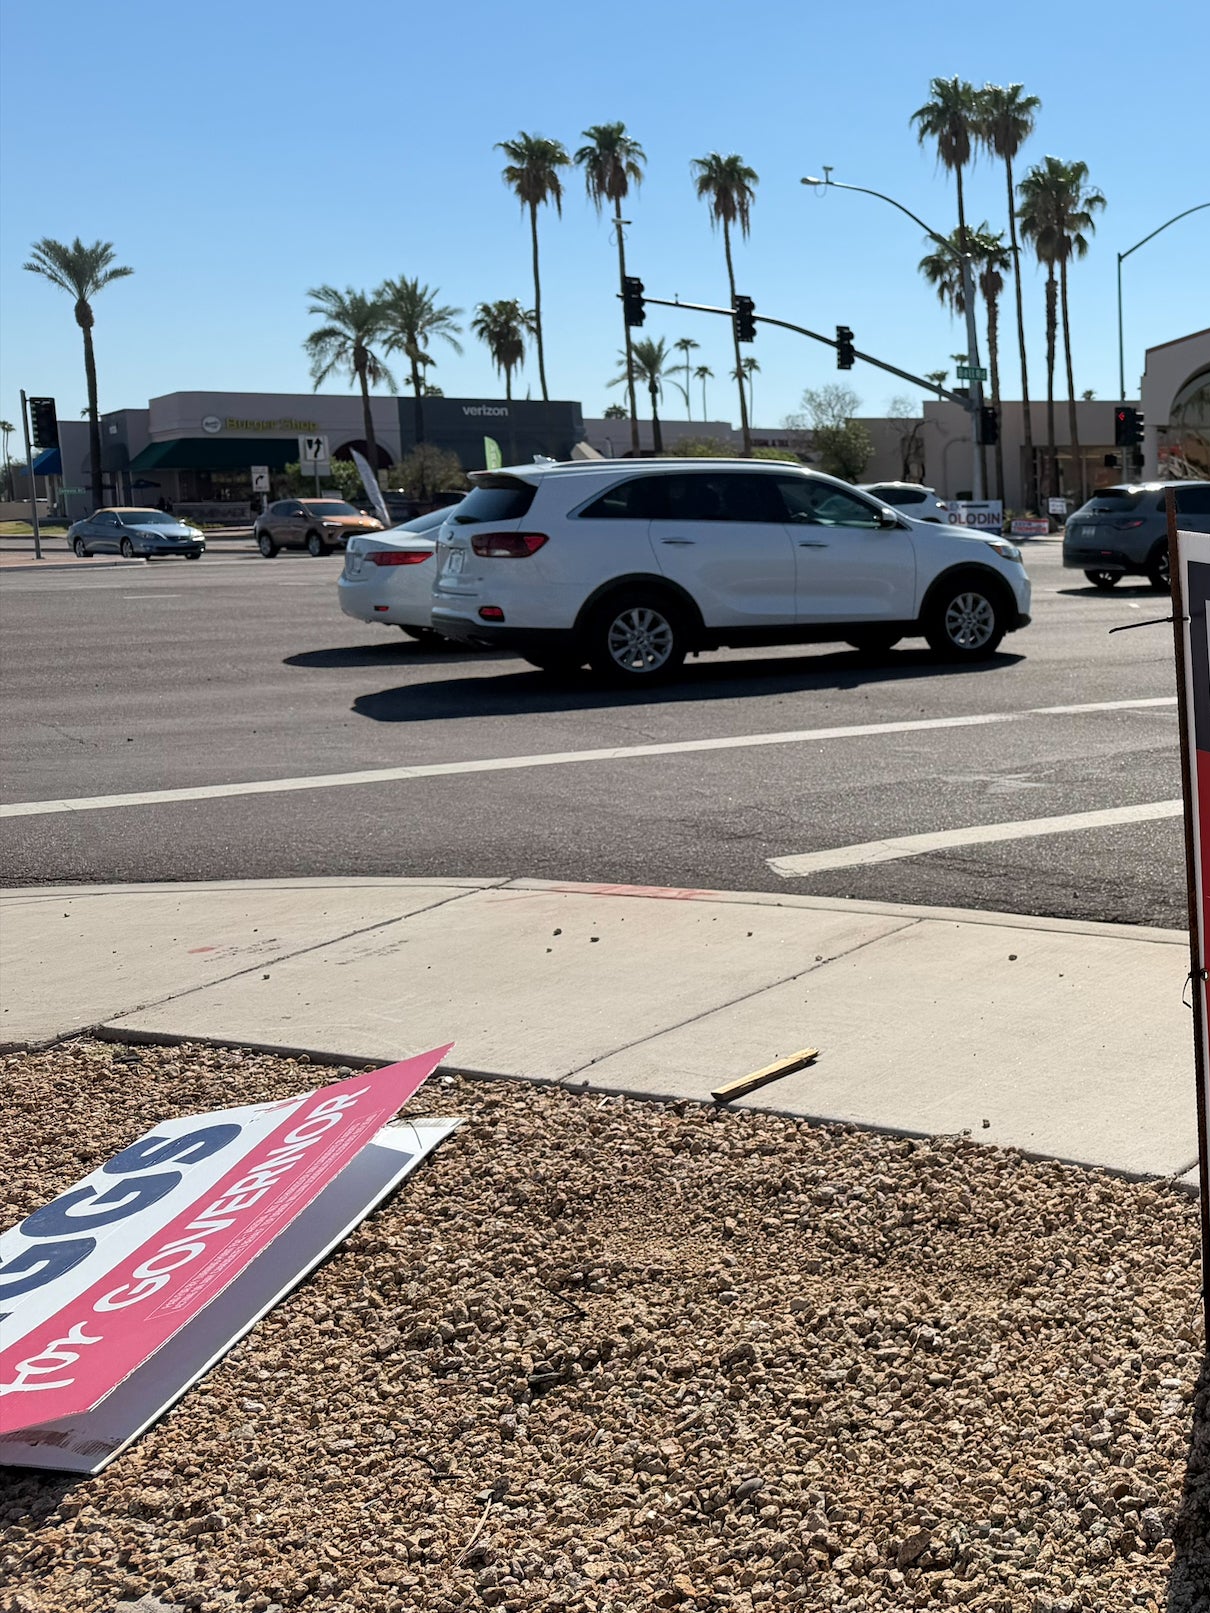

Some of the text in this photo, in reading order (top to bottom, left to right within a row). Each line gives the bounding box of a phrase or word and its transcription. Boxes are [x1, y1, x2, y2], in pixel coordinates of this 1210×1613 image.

[462, 404, 509, 416] verizon
[225, 418, 276, 432] Burger
[279, 418, 318, 432] Shop
[92, 1085, 372, 1312] GOVERNOR
